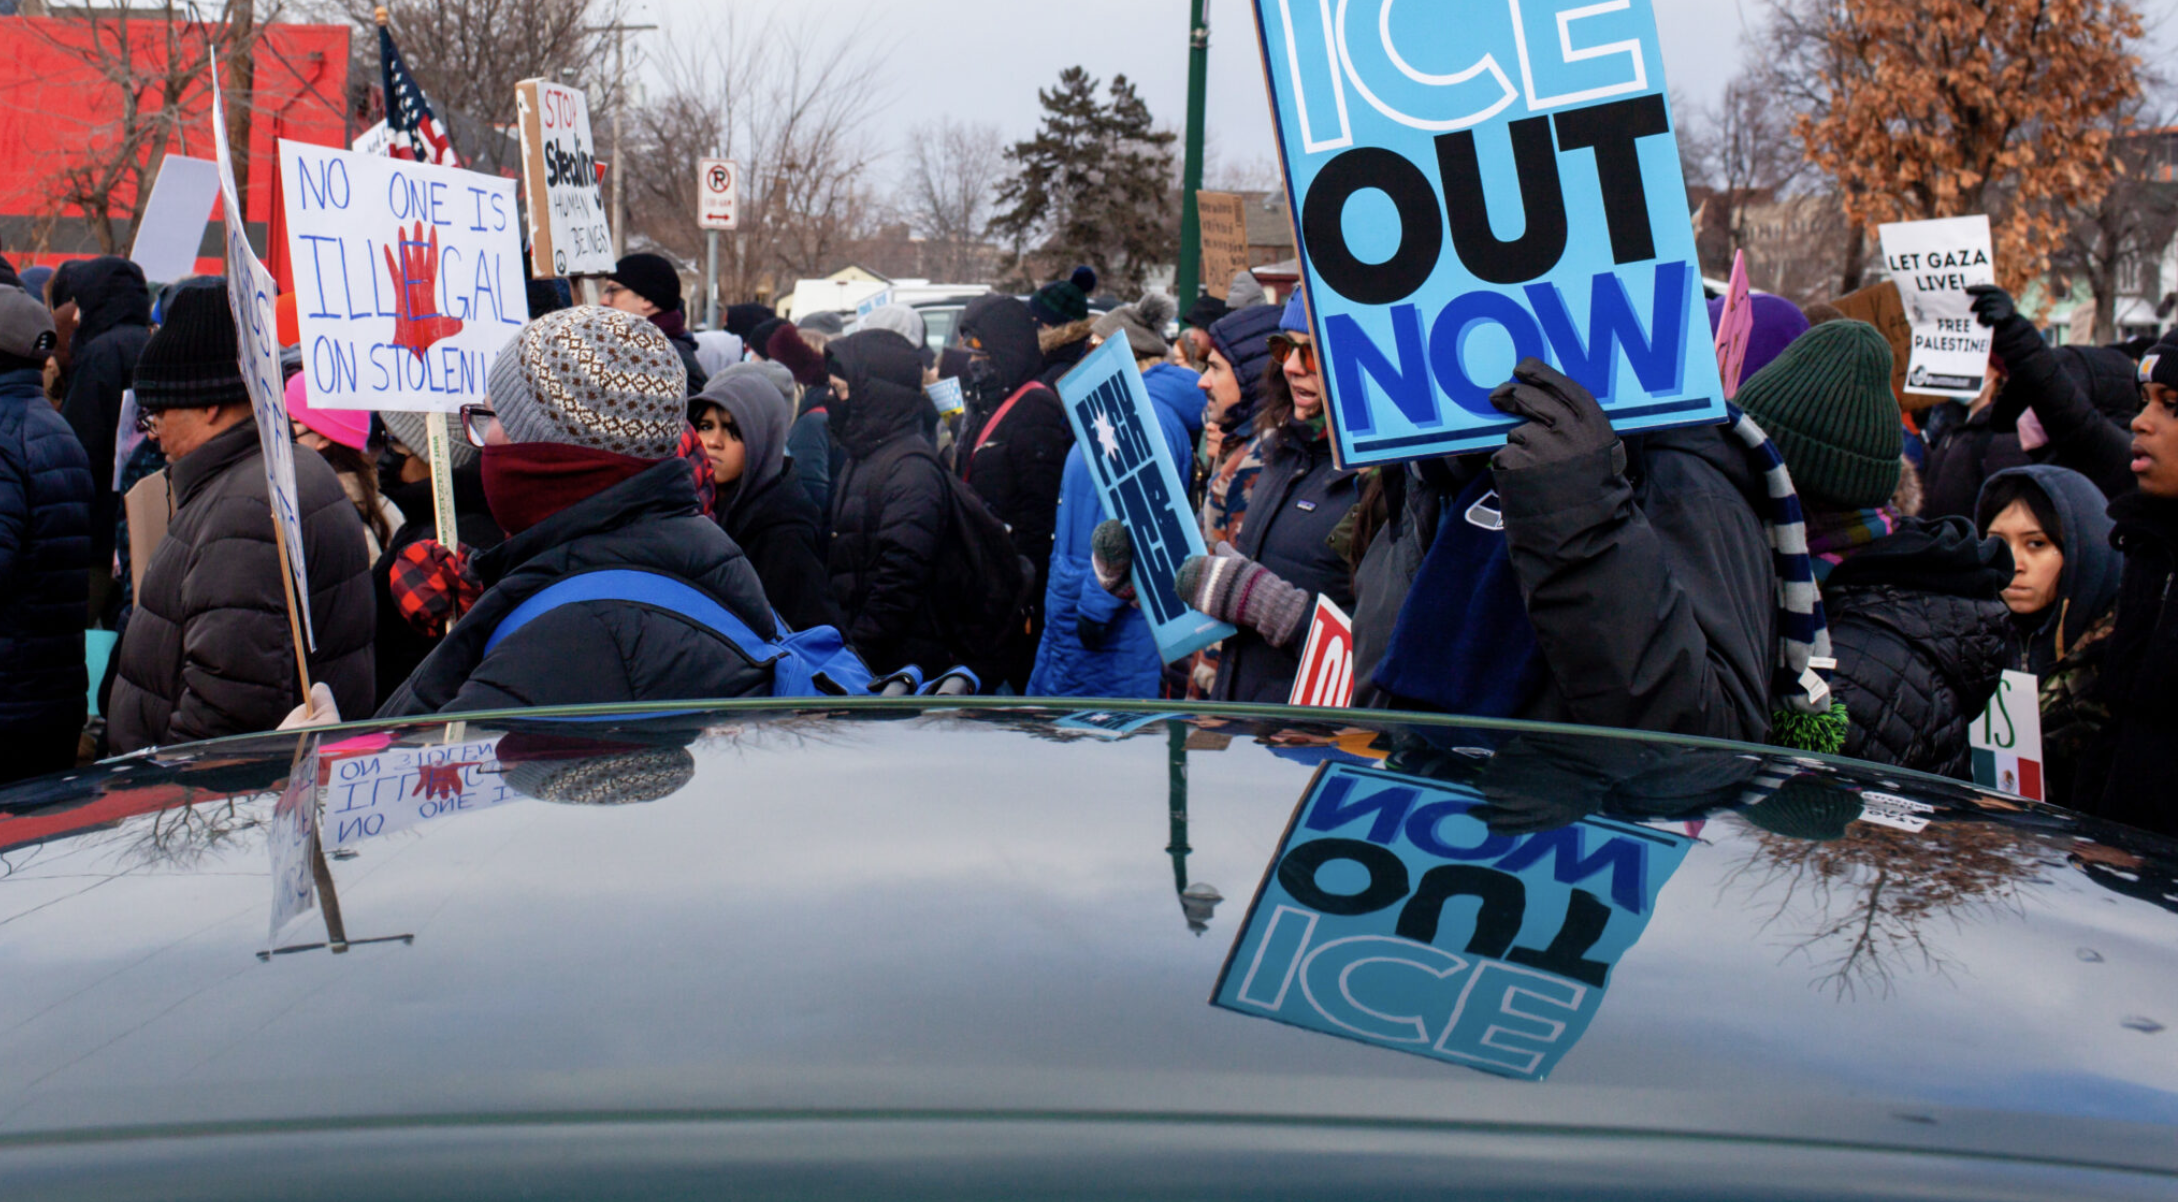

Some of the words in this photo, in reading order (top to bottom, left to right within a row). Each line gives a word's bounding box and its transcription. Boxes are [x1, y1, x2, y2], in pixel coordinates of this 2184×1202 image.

[1279, 0, 1648, 154] ICE
[298, 156, 350, 210] NO
[389, 171, 452, 226] ONE
[468, 187, 507, 232] IS
[554, 192, 590, 219] HUMAN
[1302, 92, 1670, 306] OUT
[299, 235, 522, 325] ILLEGAL
[1889, 254, 1920, 271] LET
[1927, 248, 1988, 269] GAZA
[1915, 274, 1966, 292] LIVE!
[1324, 260, 1694, 437] NOW
[1914, 335, 1990, 353] PALESTINE!
[1936, 319, 1971, 333] FREE
[313, 335, 357, 394] ON
[370, 342, 475, 395] STOLEN
